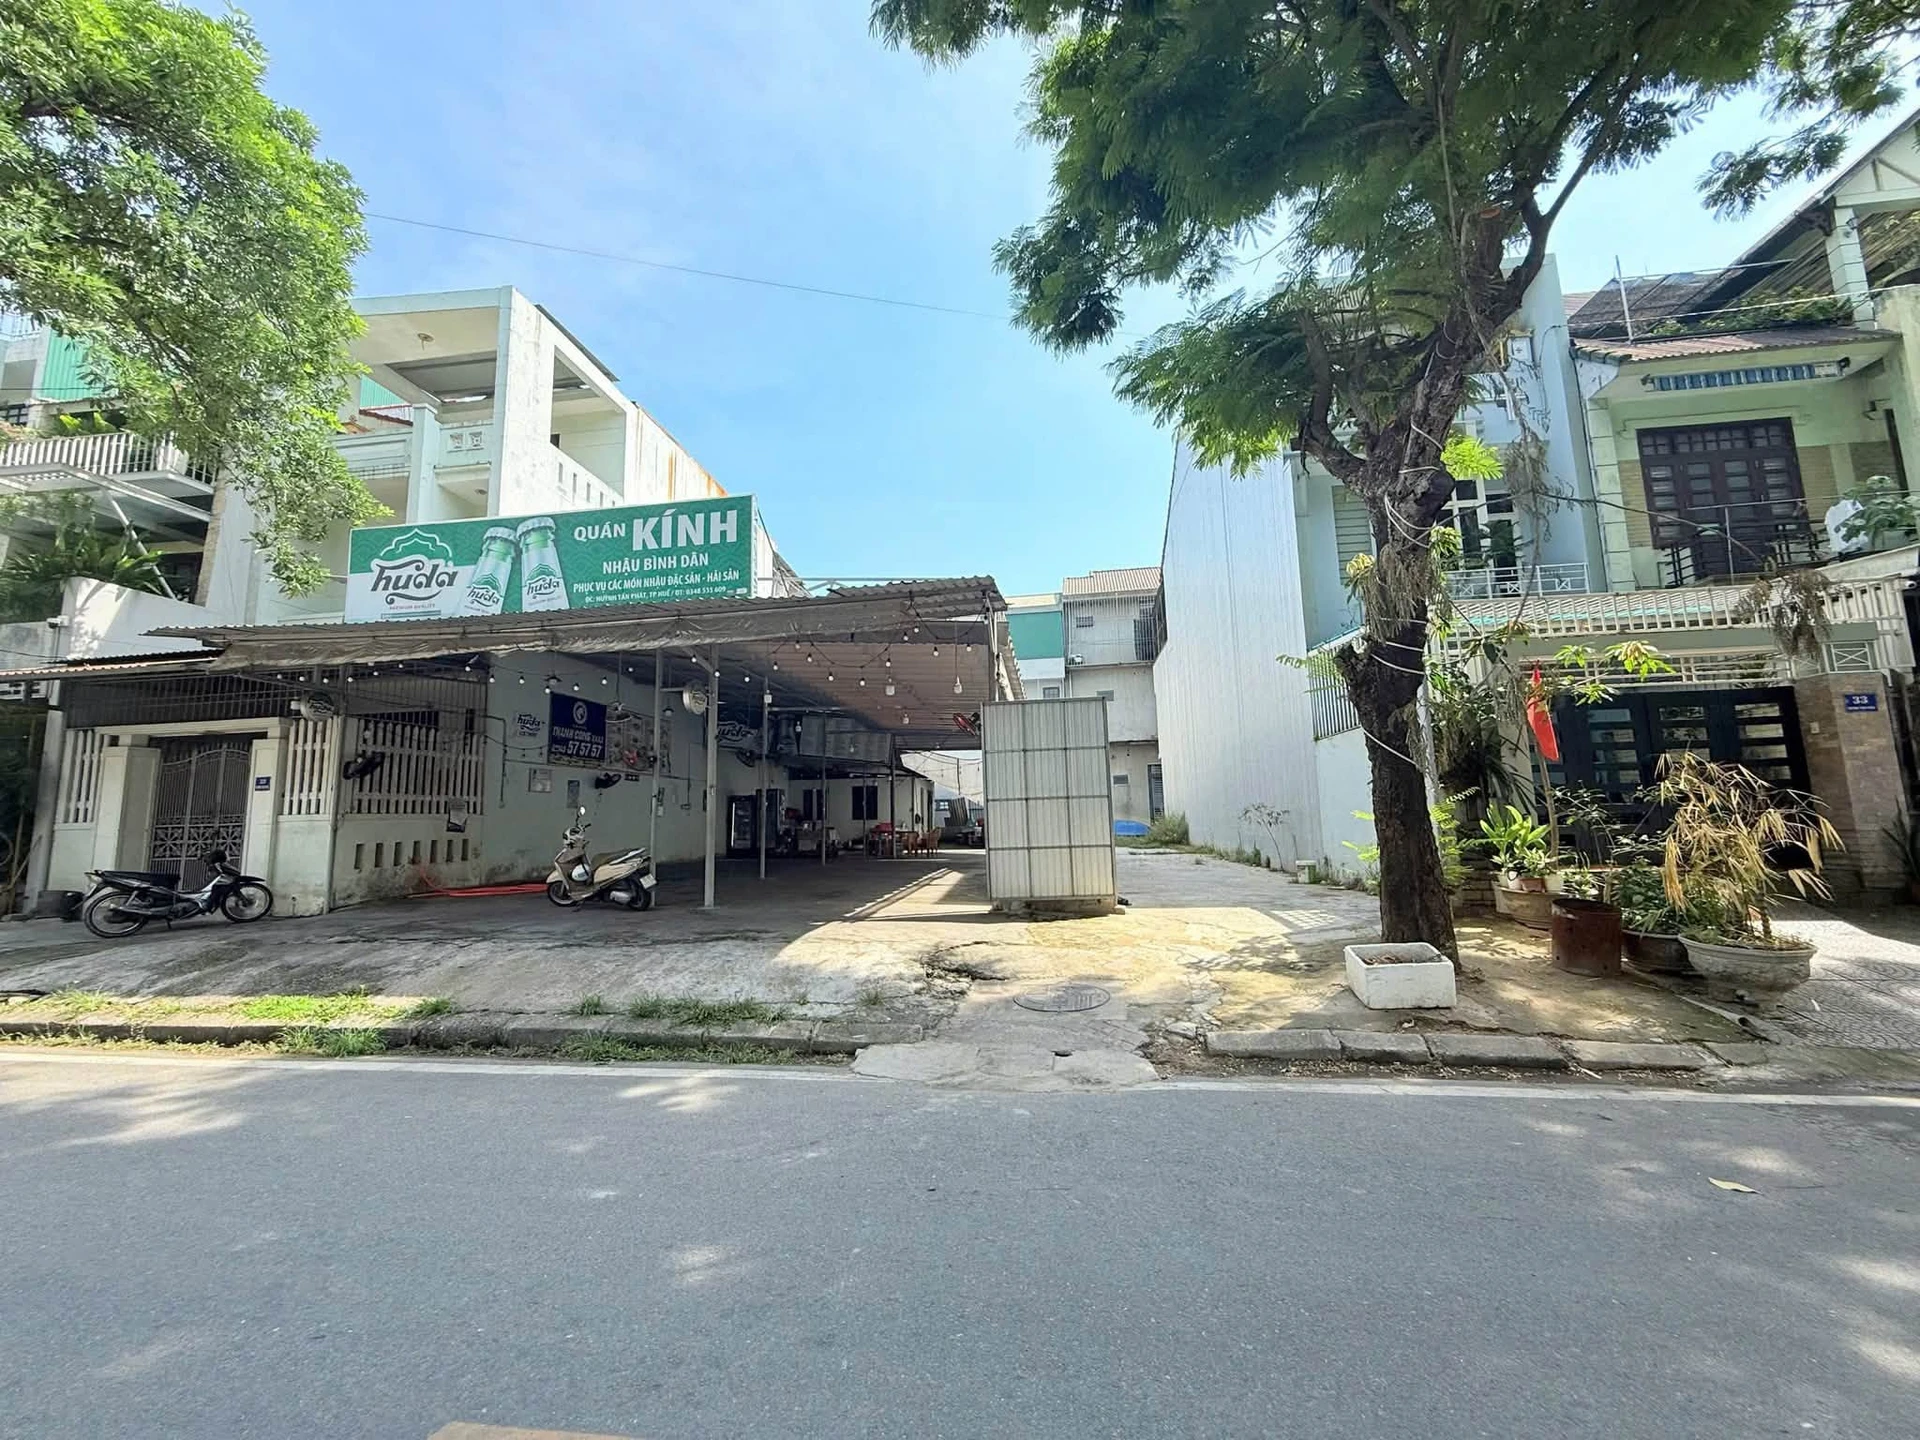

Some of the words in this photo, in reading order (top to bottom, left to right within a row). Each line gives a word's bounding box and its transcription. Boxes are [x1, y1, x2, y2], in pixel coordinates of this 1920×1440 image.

[574, 521, 626, 542] QUÁN
[632, 508, 738, 551] KÍNH
[370, 559, 459, 593] huda
[603, 557, 640, 576] NHẬU
[643, 554, 677, 571] BÌNH
[681, 551, 709, 568] DÂN
[573, 582, 595, 595] PHỤC
[595, 581, 607, 593] VỤ
[608, 578, 622, 591] CÁC
[623, 576, 642, 589] MÓN
[643, 574, 666, 589] NHẬU
[667, 573, 684, 588] ĐẶC
[685, 571, 701, 585] SẢN
[707, 569, 721, 583] HẢI
[722, 567, 740, 581] SẢN
[567, 740, 580, 755] 57
[580, 742, 591, 757] 57
[591, 744, 603, 758] 57
